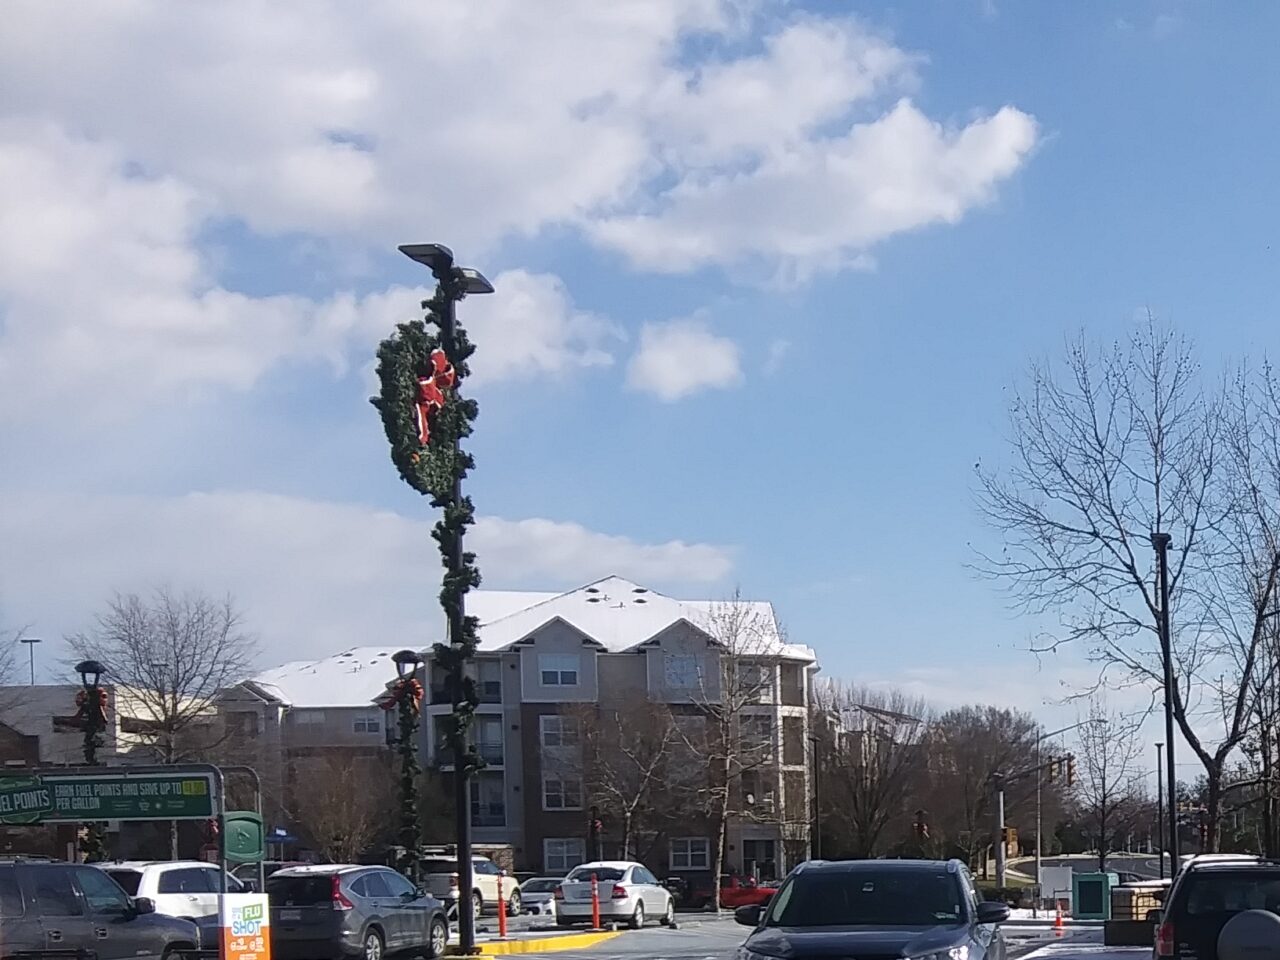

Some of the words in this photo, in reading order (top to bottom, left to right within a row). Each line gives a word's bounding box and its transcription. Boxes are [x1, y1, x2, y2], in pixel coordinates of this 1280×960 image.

[75, 783, 93, 797] FUEL
[94, 783, 121, 797] POINTS
[122, 782, 139, 796] AND
[140, 782, 159, 796] SAVE
[160, 782, 171, 795] UP
[172, 782, 182, 795] TO
[0, 793, 13, 812] EL
[13, 789, 51, 811] POINTS
[56, 797, 70, 810] PER
[71, 797, 100, 810] GALLON
[245, 905, 261, 919] FLU
[233, 920, 262, 935] SHOT
